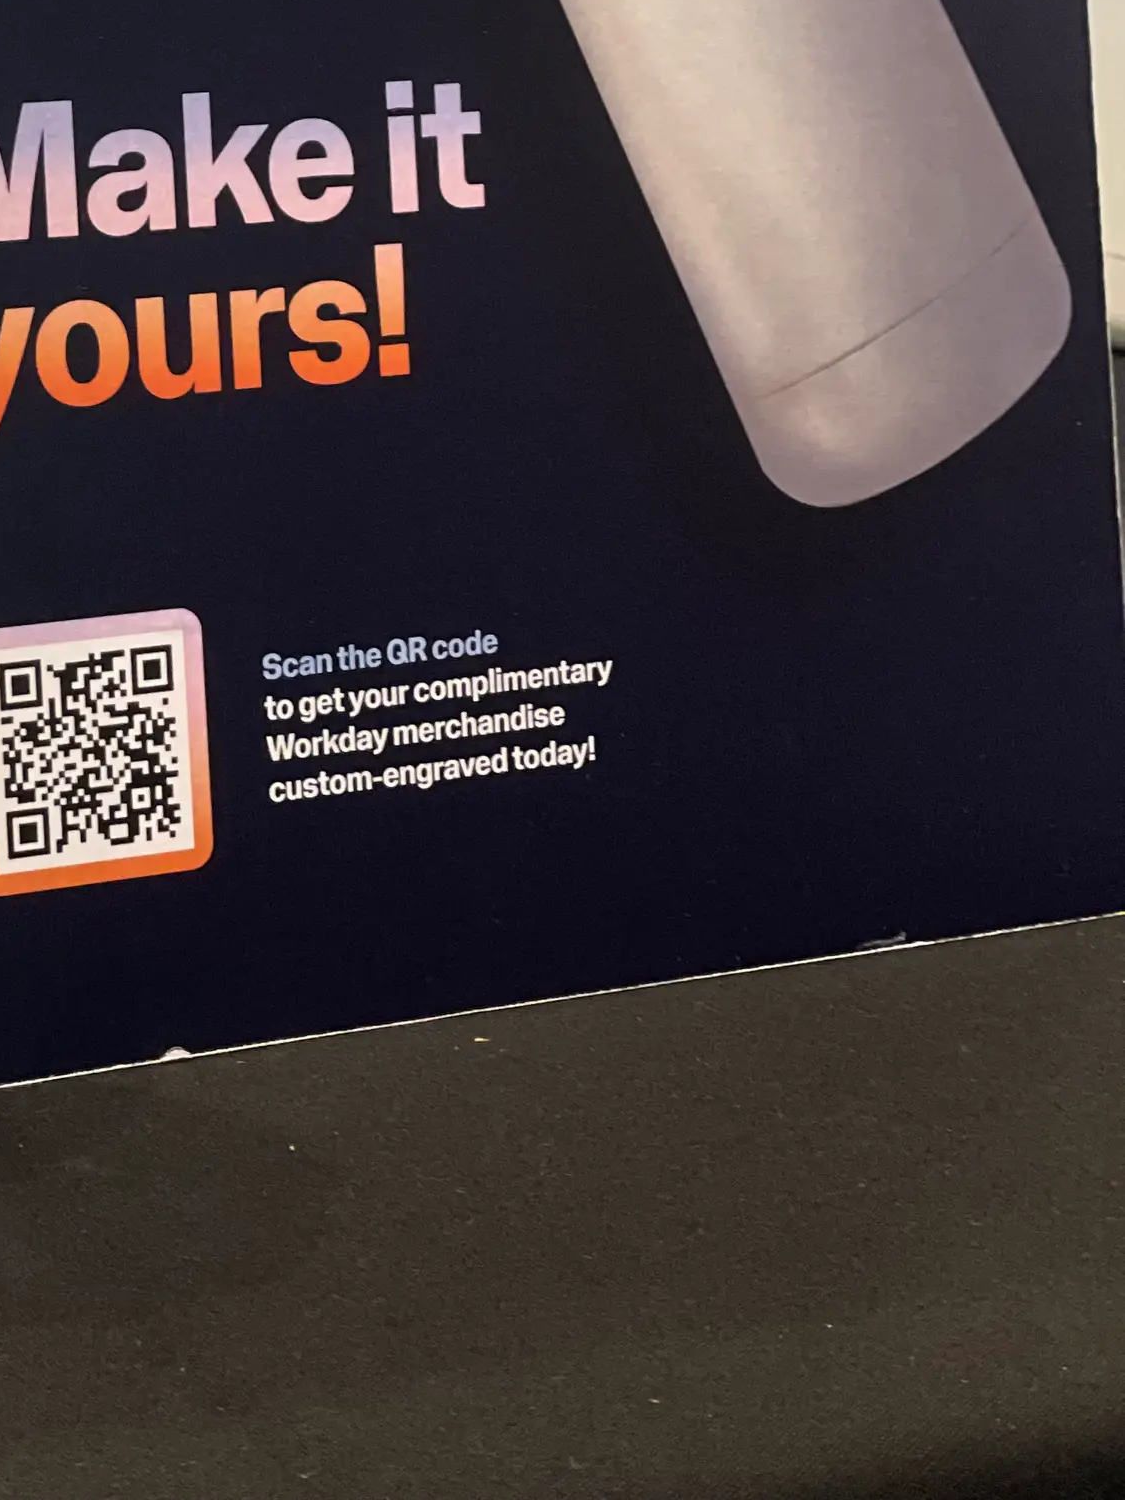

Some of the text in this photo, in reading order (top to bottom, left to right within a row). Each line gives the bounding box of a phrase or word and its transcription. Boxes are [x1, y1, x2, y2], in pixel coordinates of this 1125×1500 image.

[385, 79, 486, 214] it
[262, 629, 499, 680] Scan the QR code
[263, 659, 614, 723] to get your complimentary
[265, 703, 567, 762] Workday merchandise
[268, 735, 597, 803] custom-engraved today!
